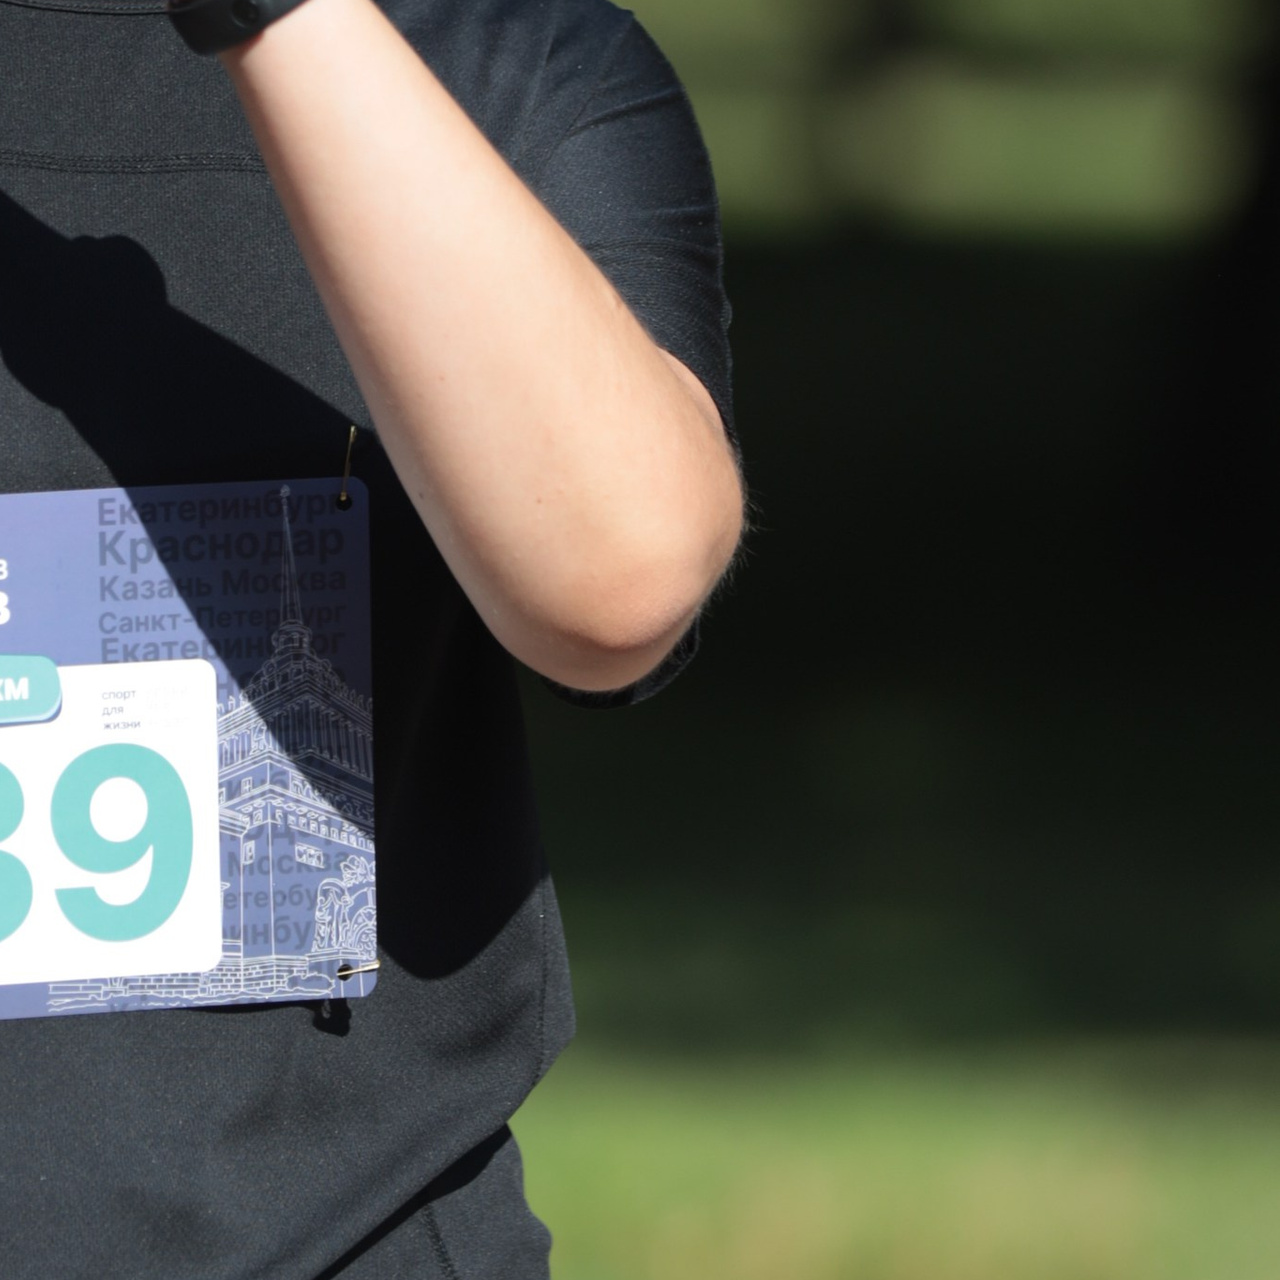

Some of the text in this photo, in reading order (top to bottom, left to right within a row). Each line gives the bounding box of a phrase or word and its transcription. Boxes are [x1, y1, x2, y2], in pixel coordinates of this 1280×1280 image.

[98, 528, 345, 574] Краснодар
[99, 569, 348, 602] Казань Москва
[98, 602, 347, 636] Санкт-Петербург
[101, 631, 347, 663] Екатеринрг
[101, 688, 137, 702] спорт
[101, 705, 125, 717] для
[103, 718, 142, 731] жизни
